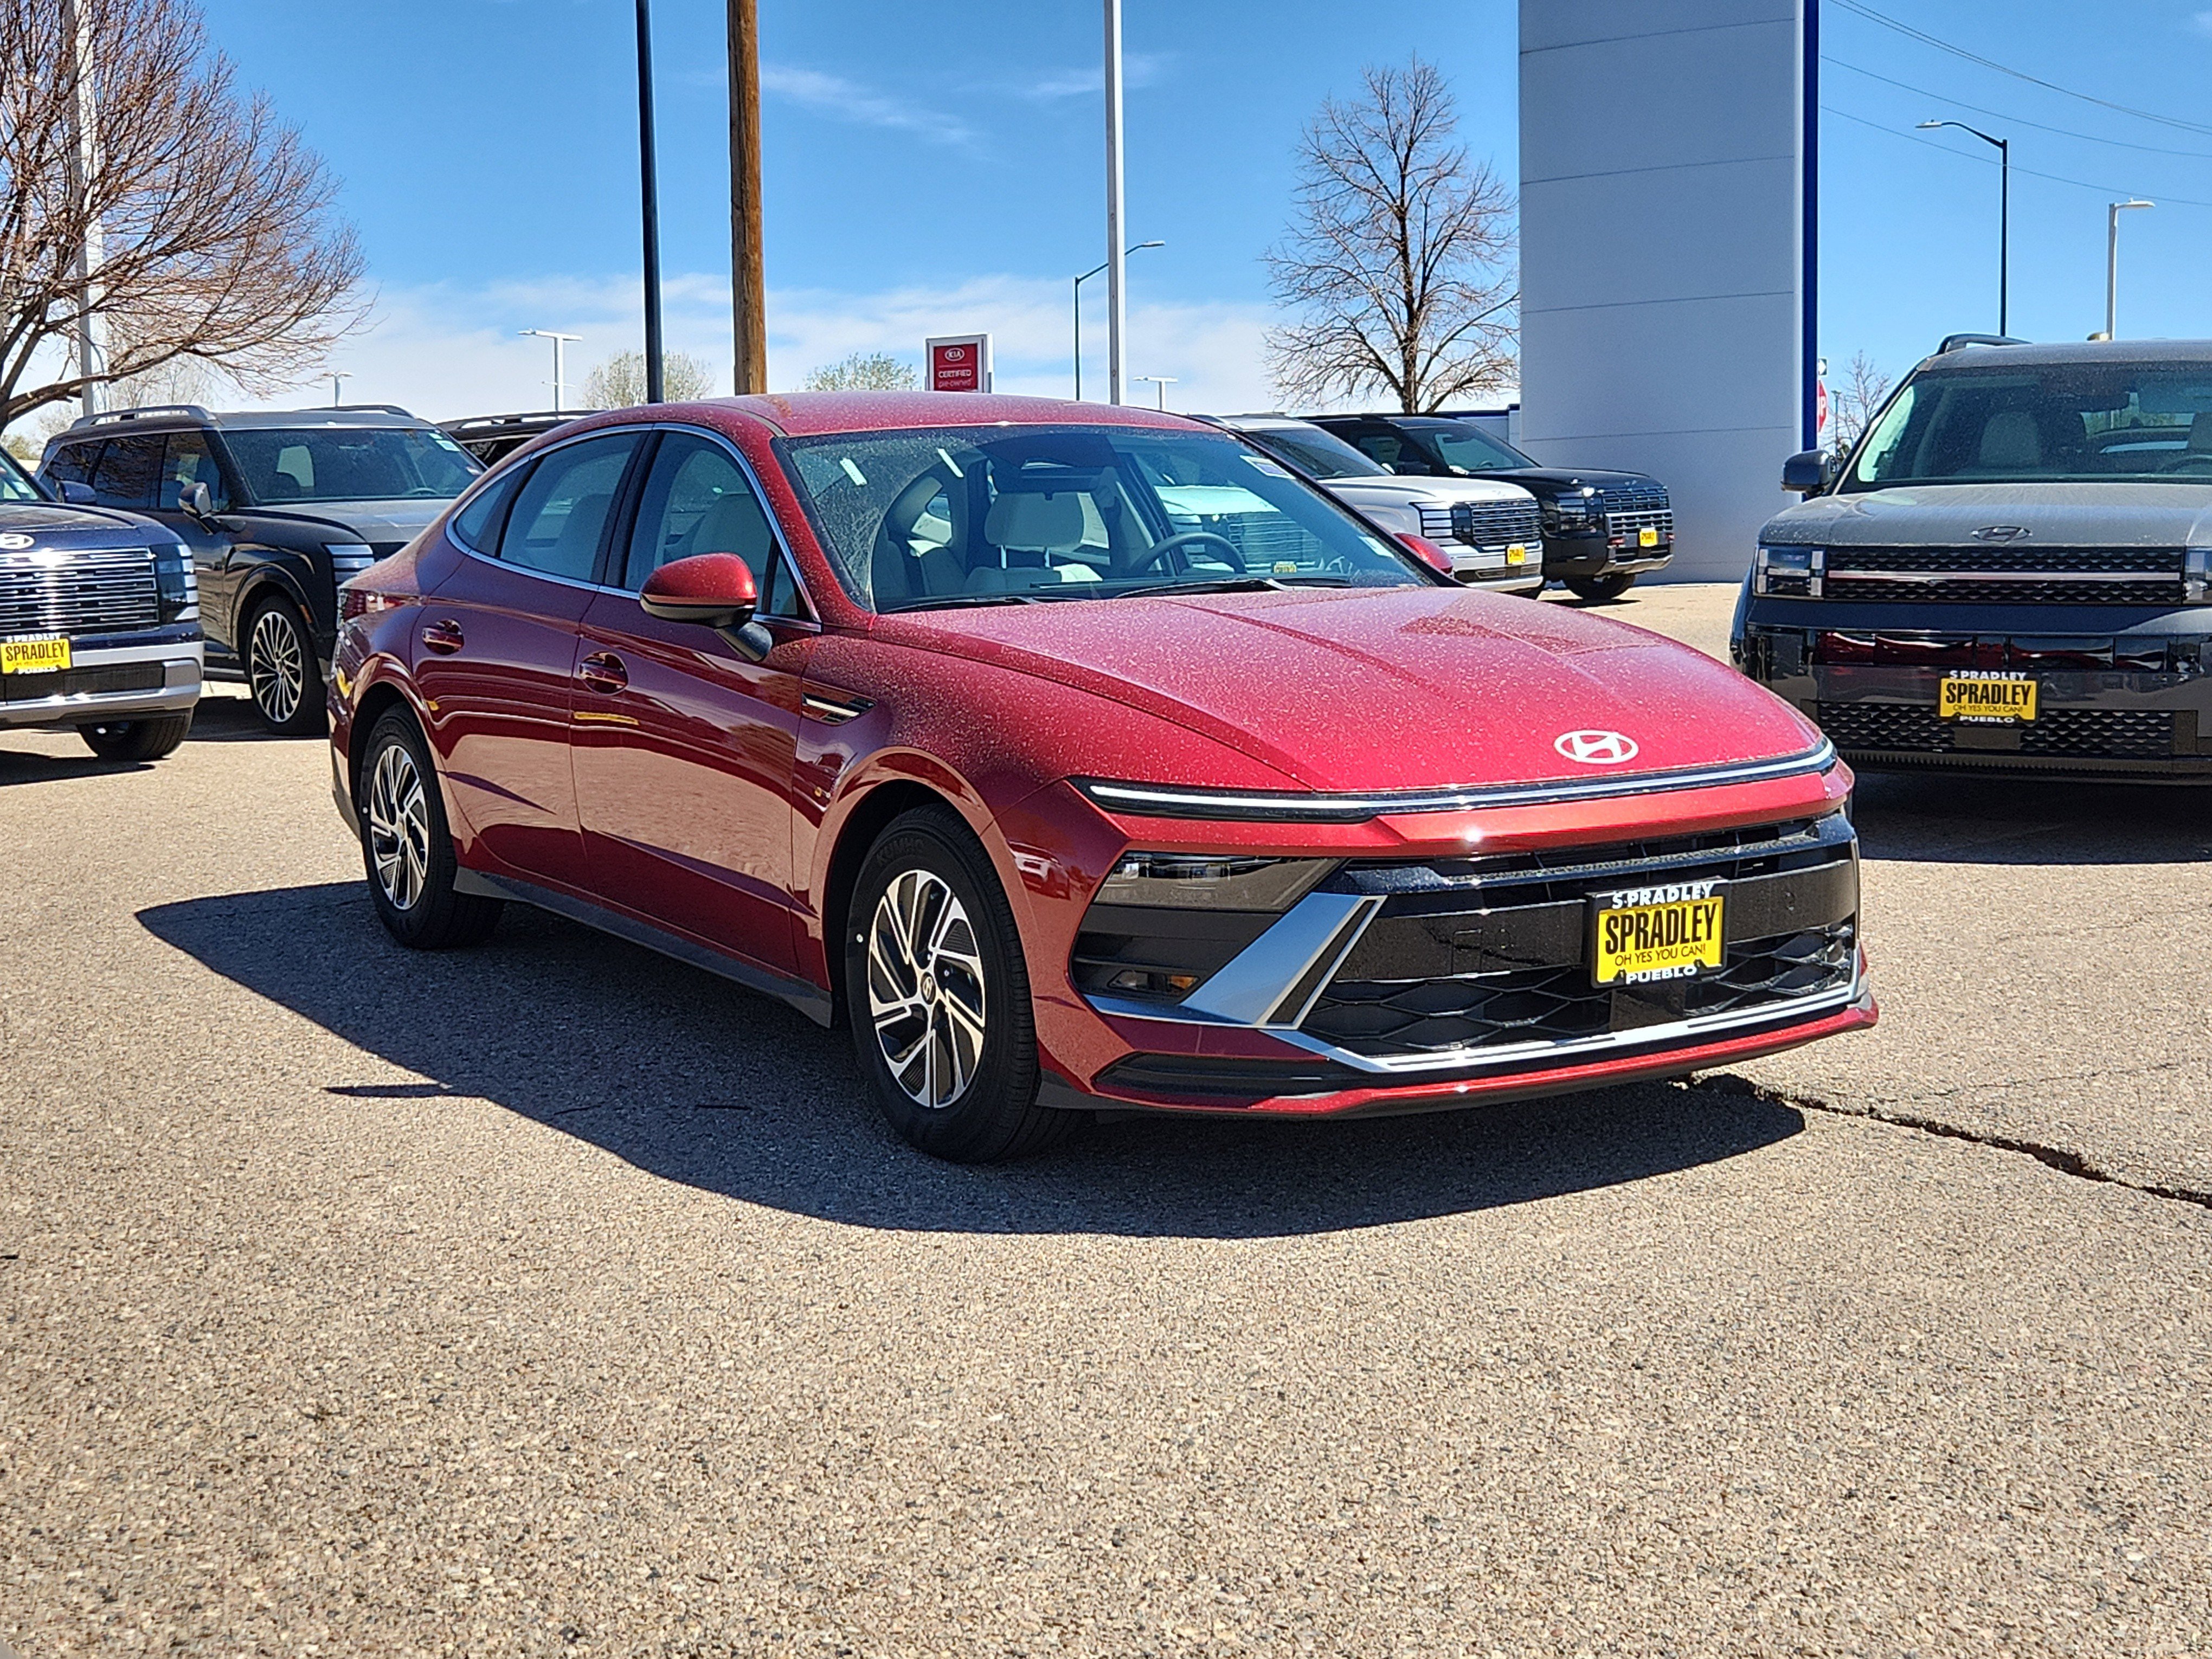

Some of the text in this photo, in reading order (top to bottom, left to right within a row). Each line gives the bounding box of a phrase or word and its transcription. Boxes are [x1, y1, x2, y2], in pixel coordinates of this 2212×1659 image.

[938, 370, 972, 378] CERTIFIED
[5, 642, 65, 661] SPRADLEY
[1949, 670, 2027, 681] SPRADLEY
[1946, 682, 2031, 705] SPRADLEY
[1959, 715, 2015, 723] PUEBLO
[1612, 883, 1714, 909] SPRADLEY
[1605, 902, 1717, 955] SPRADLEY
[1615, 943, 1706, 966] OH YES YOU CAN!
[1626, 965, 1697, 985] PUEBLO
